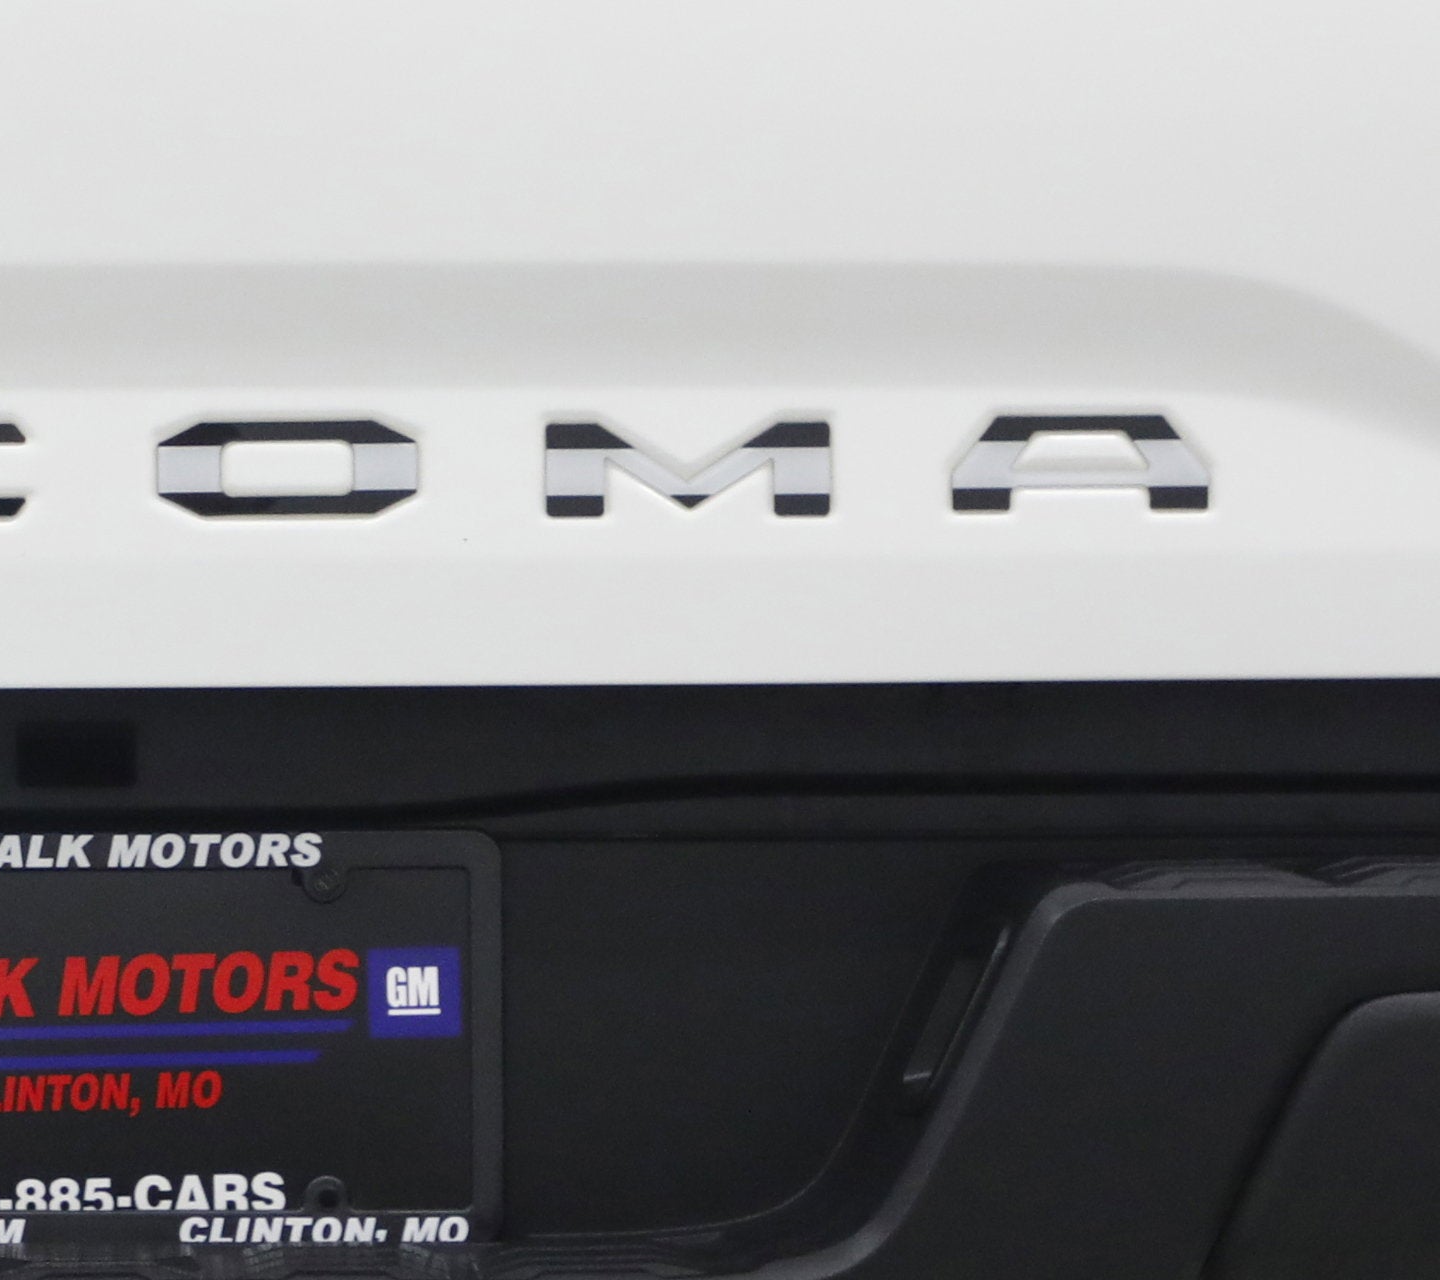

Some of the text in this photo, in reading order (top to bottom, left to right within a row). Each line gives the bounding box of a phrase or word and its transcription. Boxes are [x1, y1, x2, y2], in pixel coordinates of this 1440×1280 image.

[107, 832, 323, 869] MOTORS
[58, 948, 361, 1018] MOTORS
[385, 965, 441, 1008] GM
[155, 1070, 223, 1110] MO
[178, 1215, 470, 1243] CLINTON, MO
